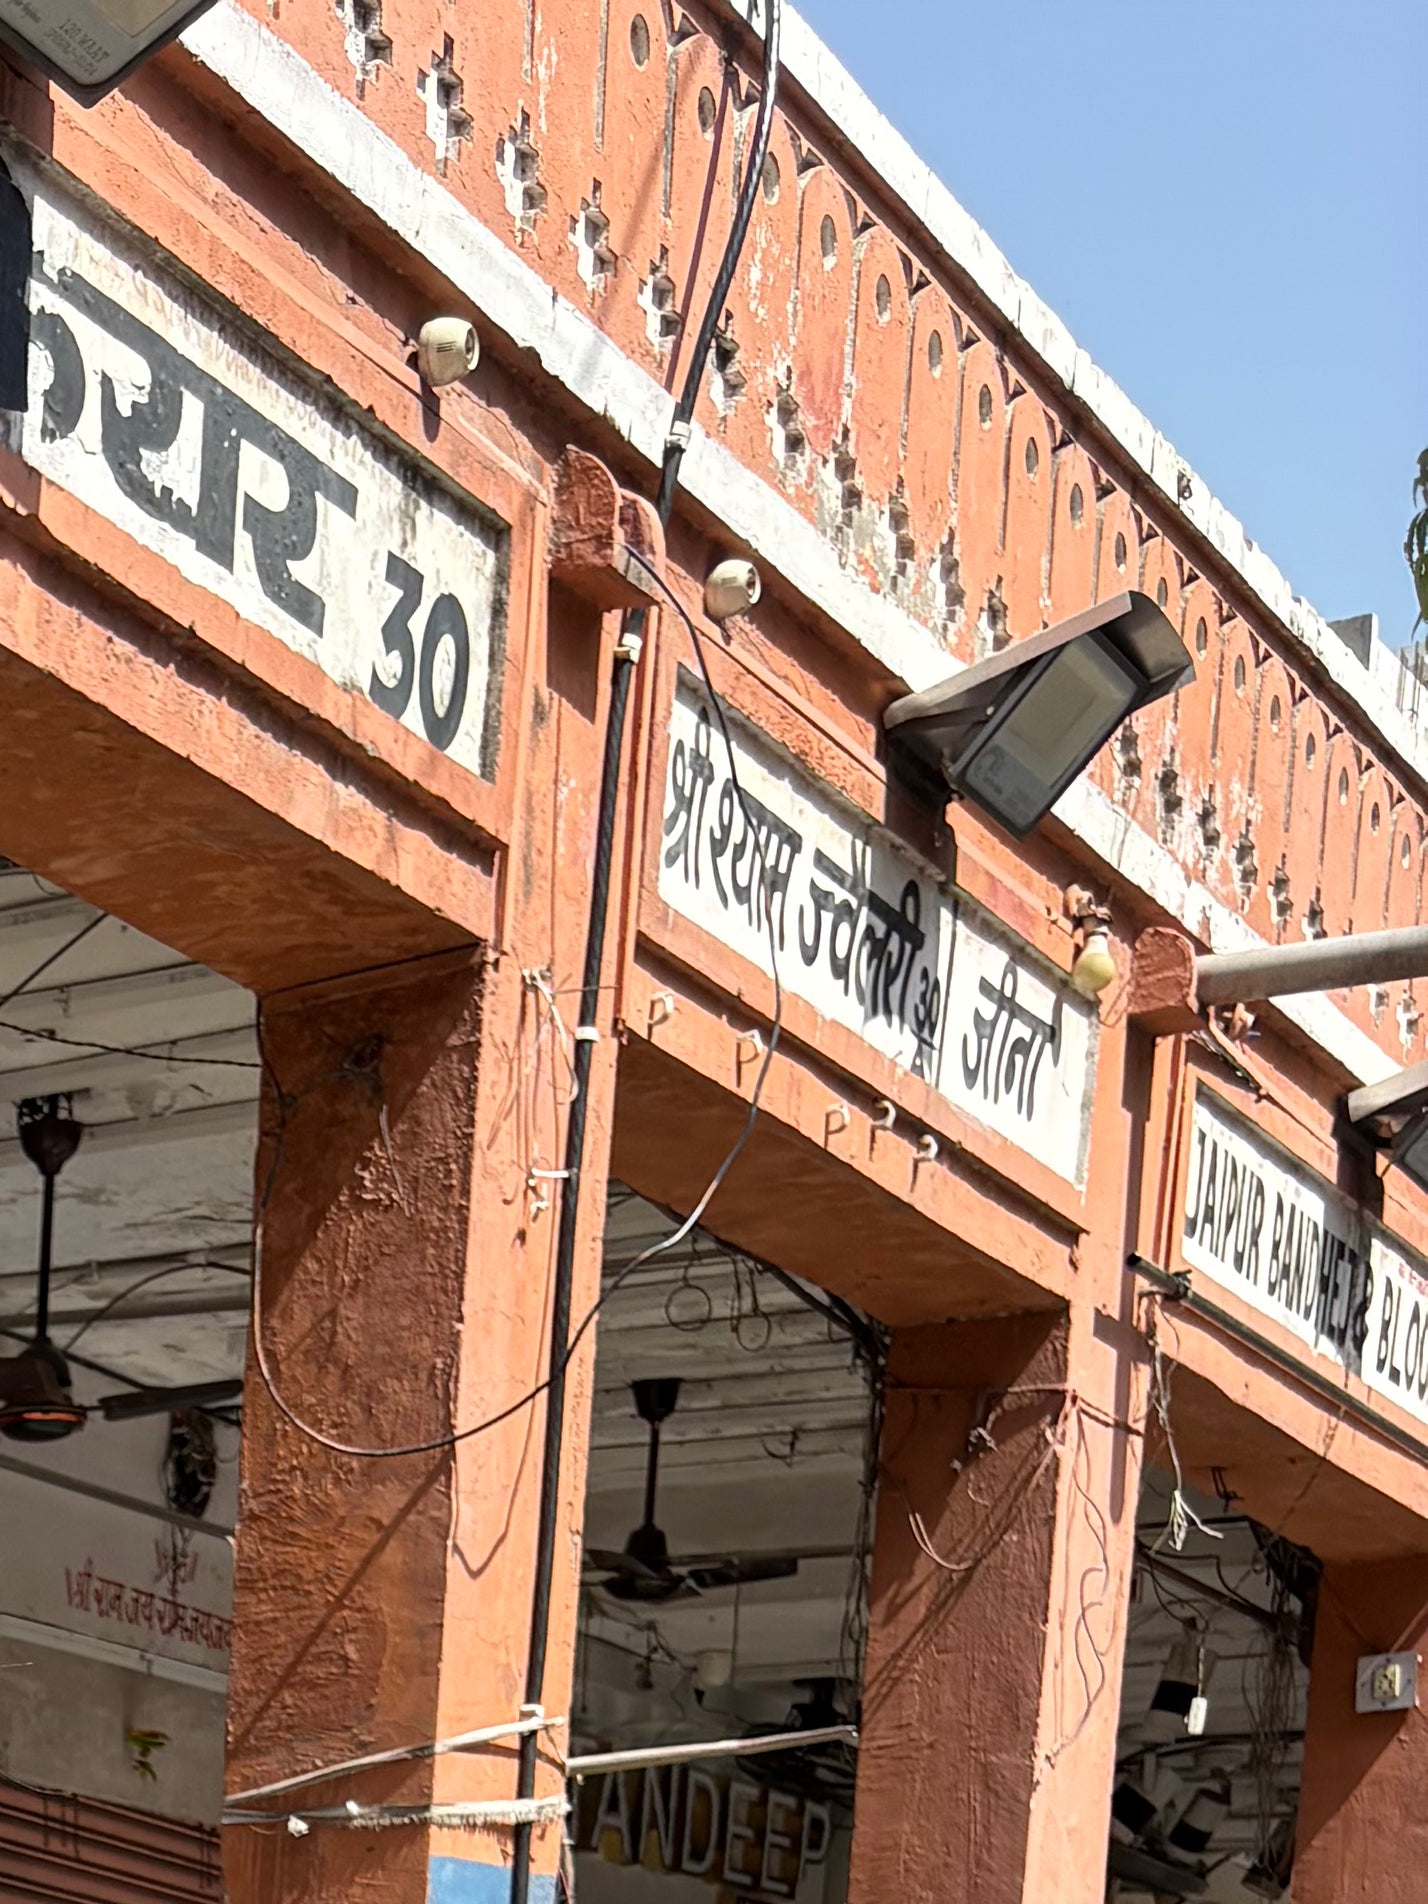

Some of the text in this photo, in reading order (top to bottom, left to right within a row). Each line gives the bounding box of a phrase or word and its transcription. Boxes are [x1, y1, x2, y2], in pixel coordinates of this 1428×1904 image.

[369, 550, 469, 753] 30
[914, 966, 942, 1040] 30
[1184, 1126, 1265, 1288] JAIPUR
[569, 1765, 831, 1894] ANDEEP
